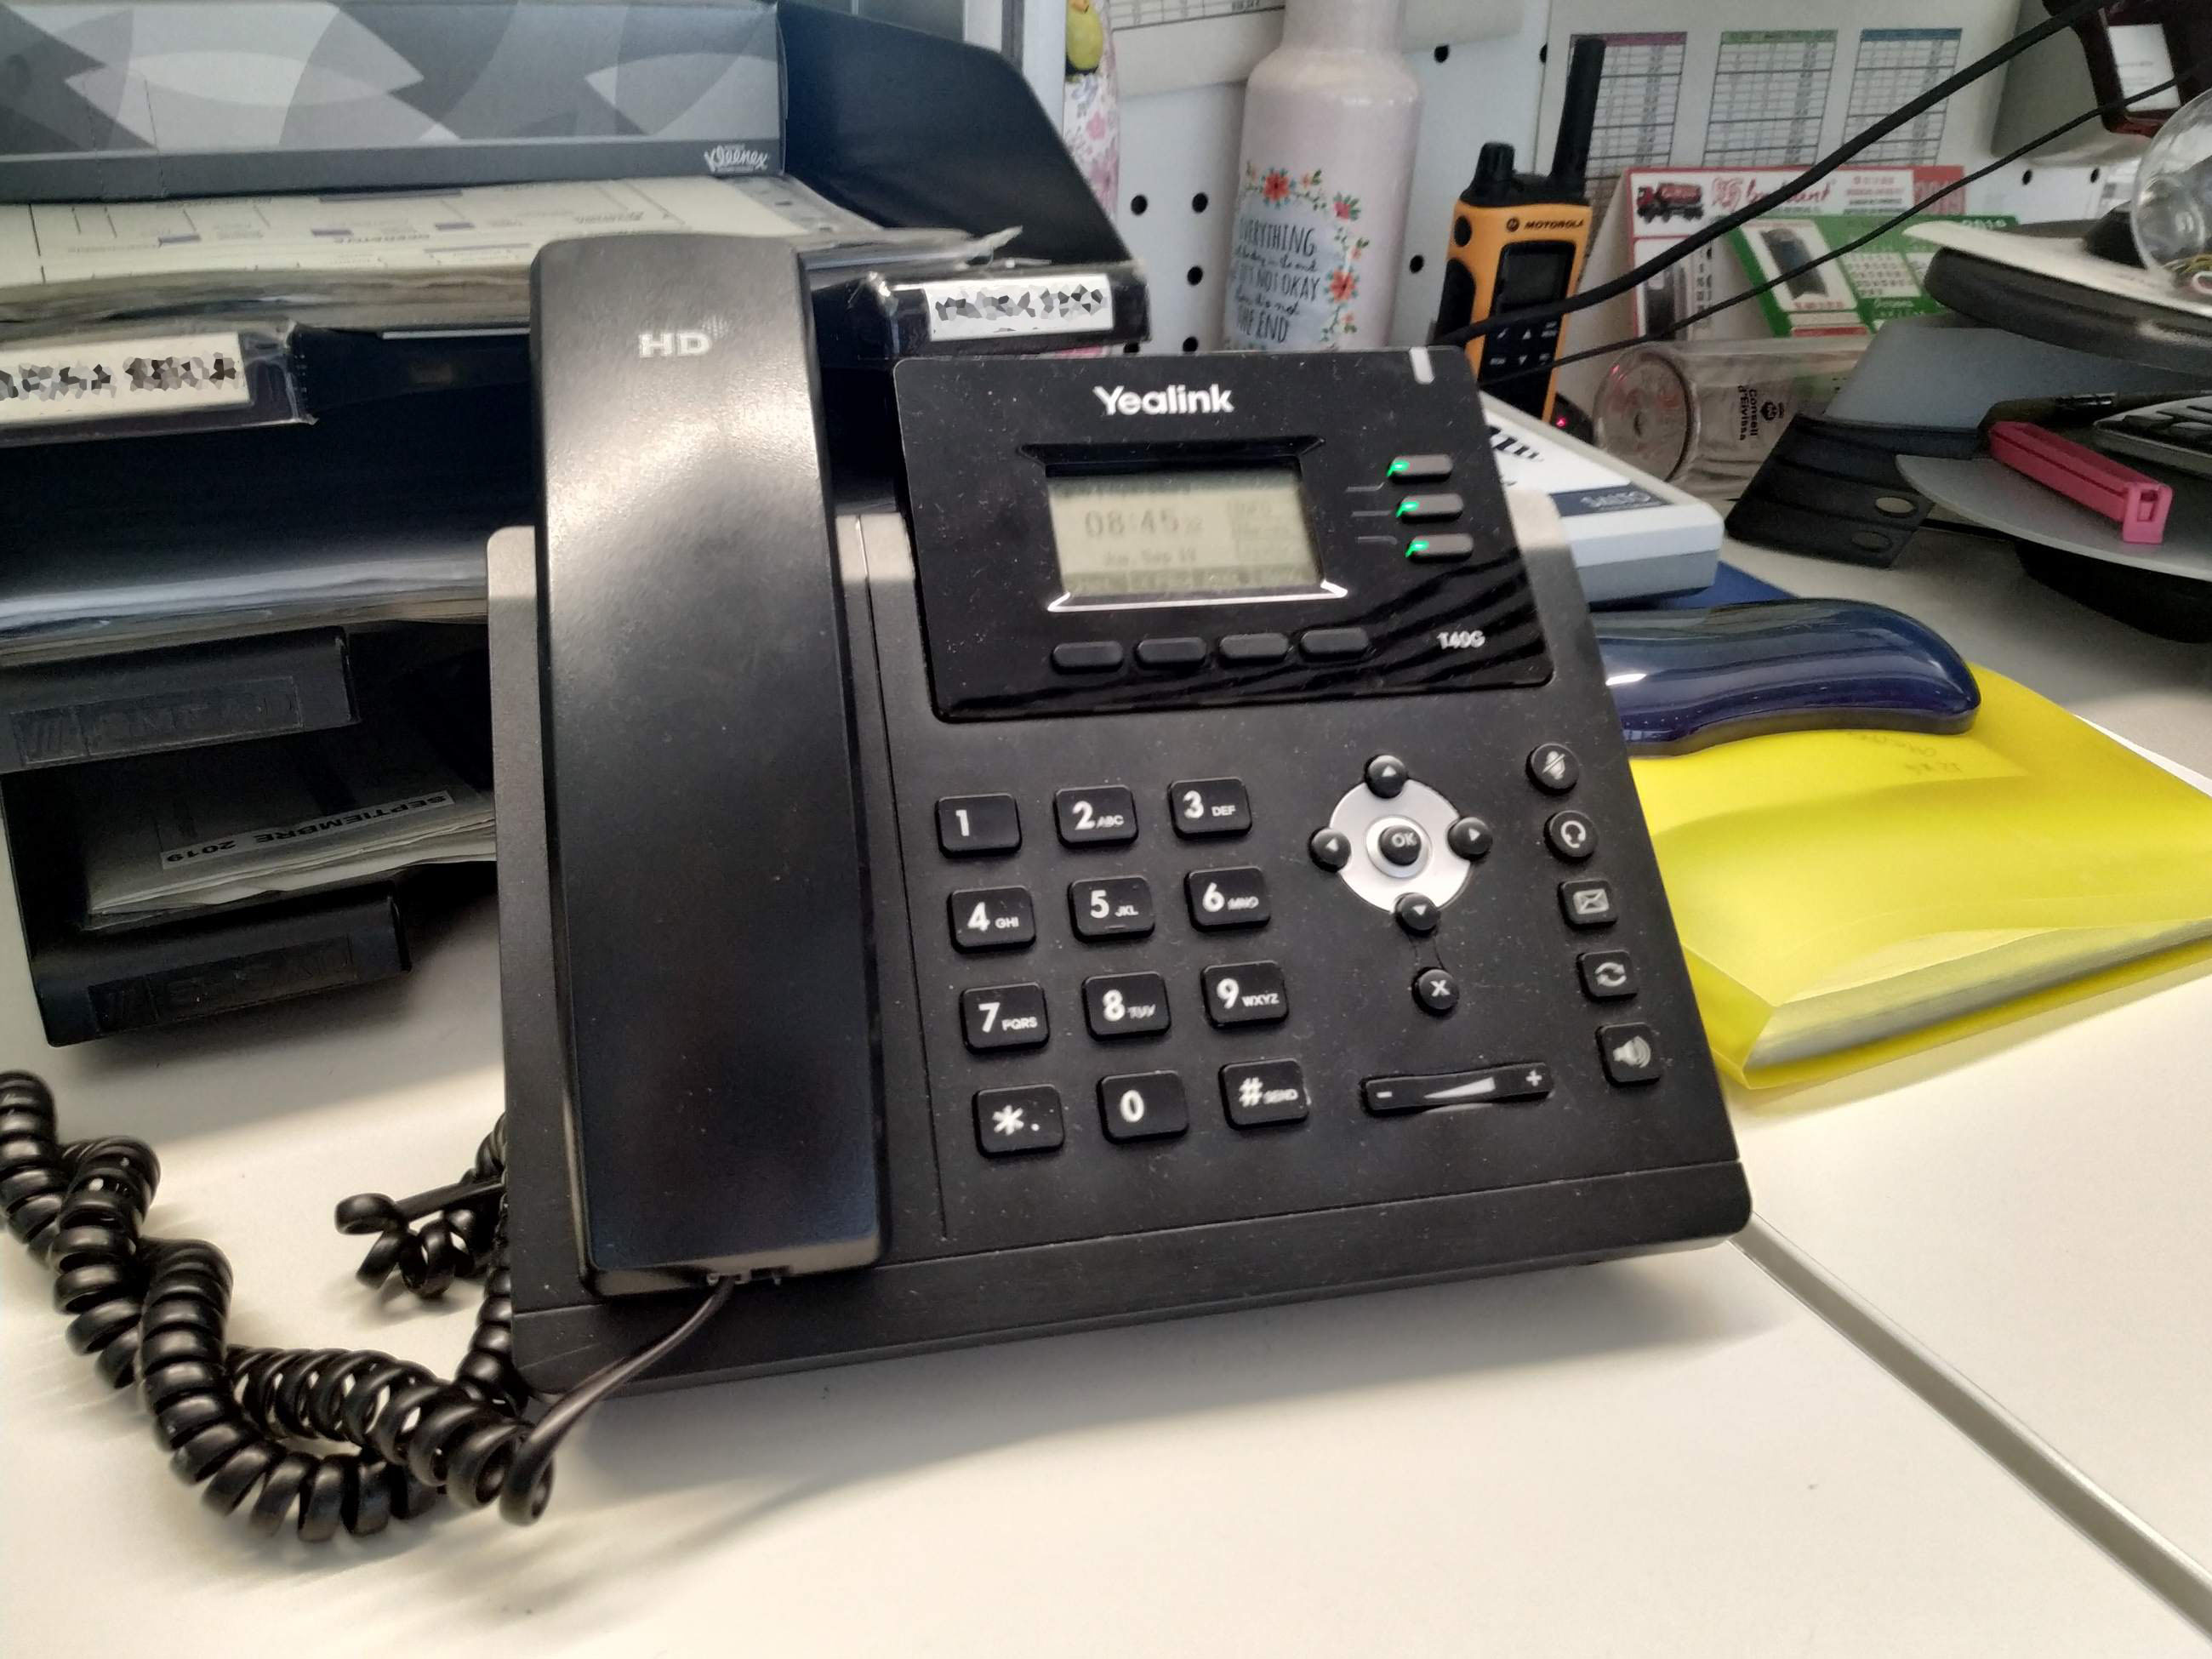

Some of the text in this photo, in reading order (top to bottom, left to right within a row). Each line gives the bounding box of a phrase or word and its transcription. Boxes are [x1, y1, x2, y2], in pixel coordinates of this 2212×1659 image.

[704, 145, 768, 172] Kleenex
[1524, 219, 1584, 230] MOTOROLA
[1281, 273, 1320, 301] OKAY
[1256, 311, 1289, 343] END
[639, 333, 710, 357] HD
[1092, 384, 1234, 415] Yealink
[1749, 389, 1759, 436] Consell
[1436, 630, 1485, 649] T40G
[1073, 801, 1124, 830] 2 ABC
[1183, 790, 1236, 818] 3 DEF
[167, 795, 447, 863] SEPTIEMBRE 2019
[955, 809, 970, 837] 1
[1391, 830, 1416, 848] OK
[1090, 890, 1139, 919] 5 JKL
[1202, 882, 1225, 912] 6
[967, 902, 1019, 932] 4 GHI
[1104, 990, 1125, 1021] 8
[1217, 978, 1280, 1009] 9 WXYZ
[978, 1001, 1038, 1033] 7 PQRS
[1120, 1090, 1145, 1123] 0
